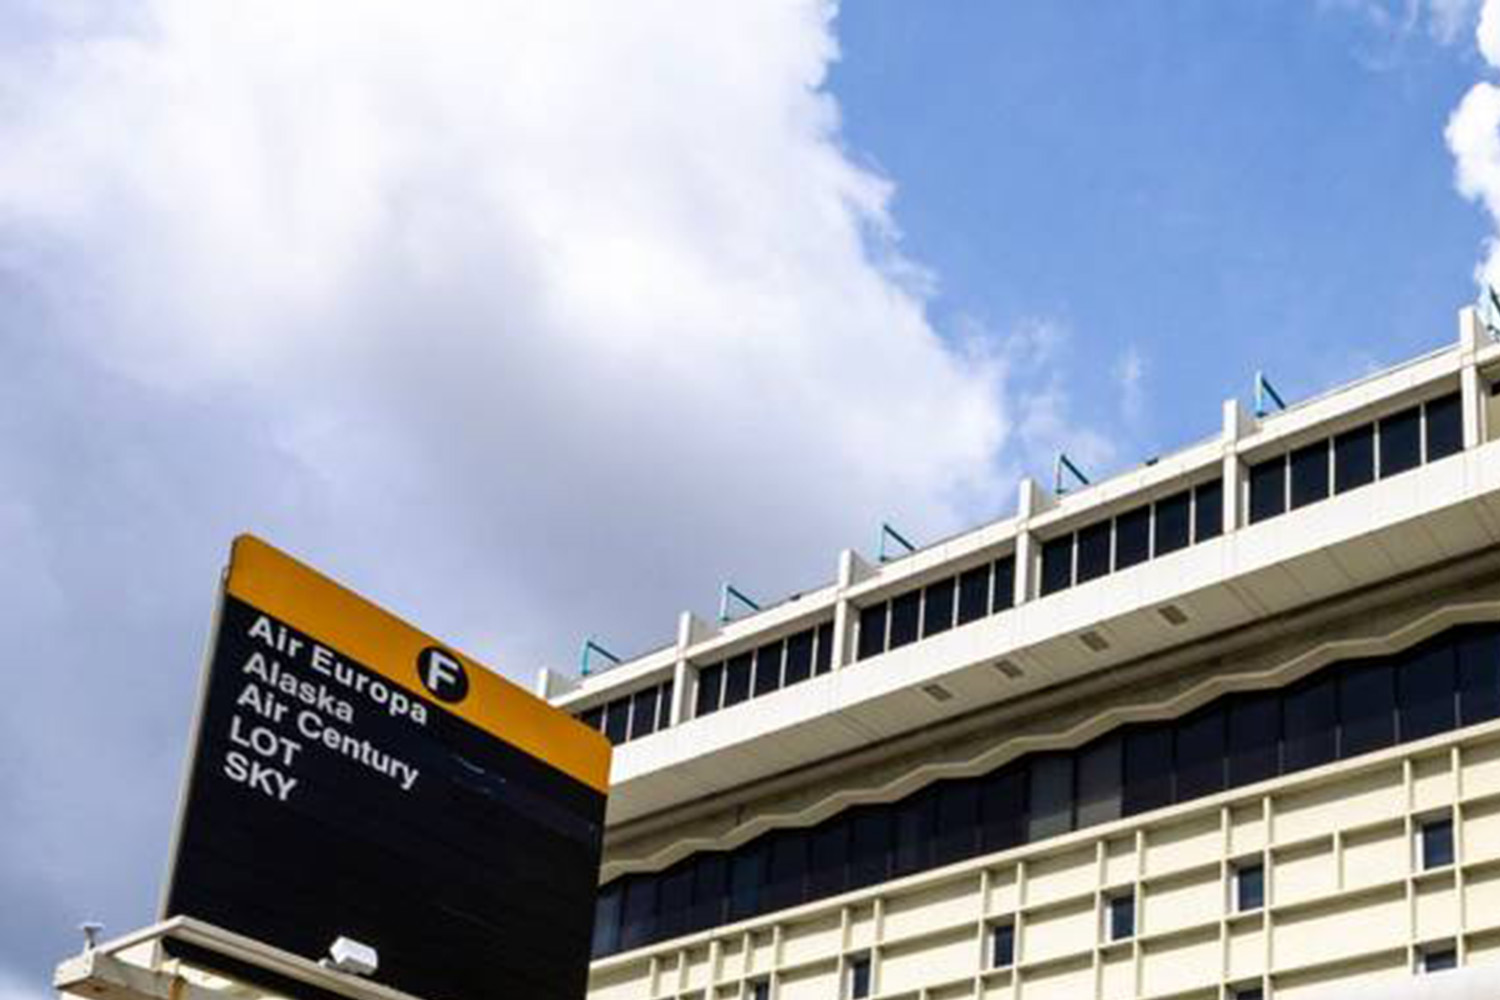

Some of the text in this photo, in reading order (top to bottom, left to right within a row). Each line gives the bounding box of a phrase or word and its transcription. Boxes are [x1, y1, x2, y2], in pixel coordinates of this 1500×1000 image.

[242, 652, 353, 723] Alaska
[249, 616, 429, 725] Air Europa
[427, 650, 459, 690] F
[230, 715, 302, 766] LOT
[237, 683, 419, 790] Air Century
[223, 751, 297, 801] SKY
